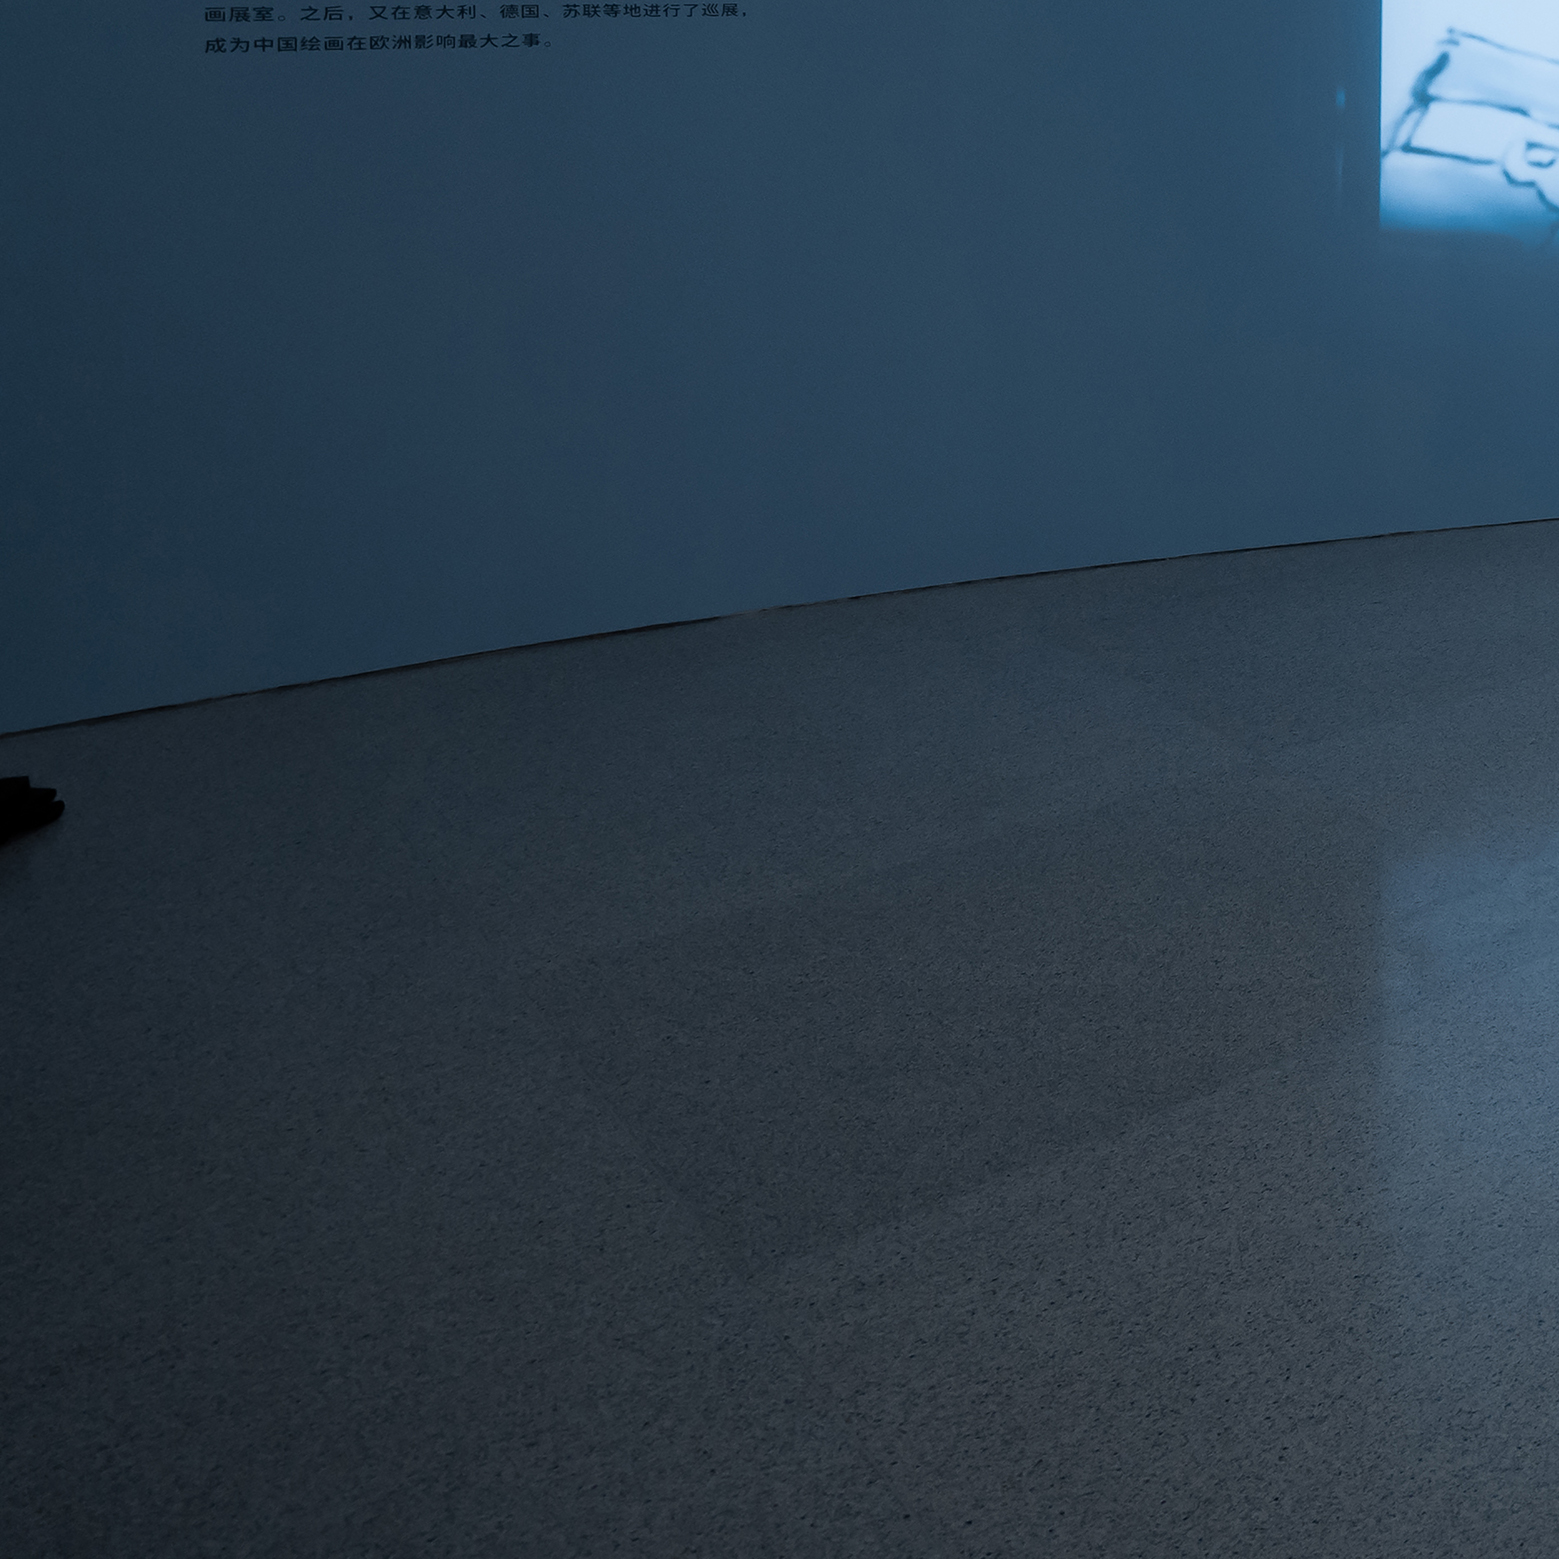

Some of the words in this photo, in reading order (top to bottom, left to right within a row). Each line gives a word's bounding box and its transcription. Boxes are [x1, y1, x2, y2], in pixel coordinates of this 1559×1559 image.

[204, 2, 748, 23] 画展室。之后，又在意大利、德国、苏联等地进行了巡展，
[205, 32, 553, 54] 成为中国绘画在欧洲影响最大之事。
